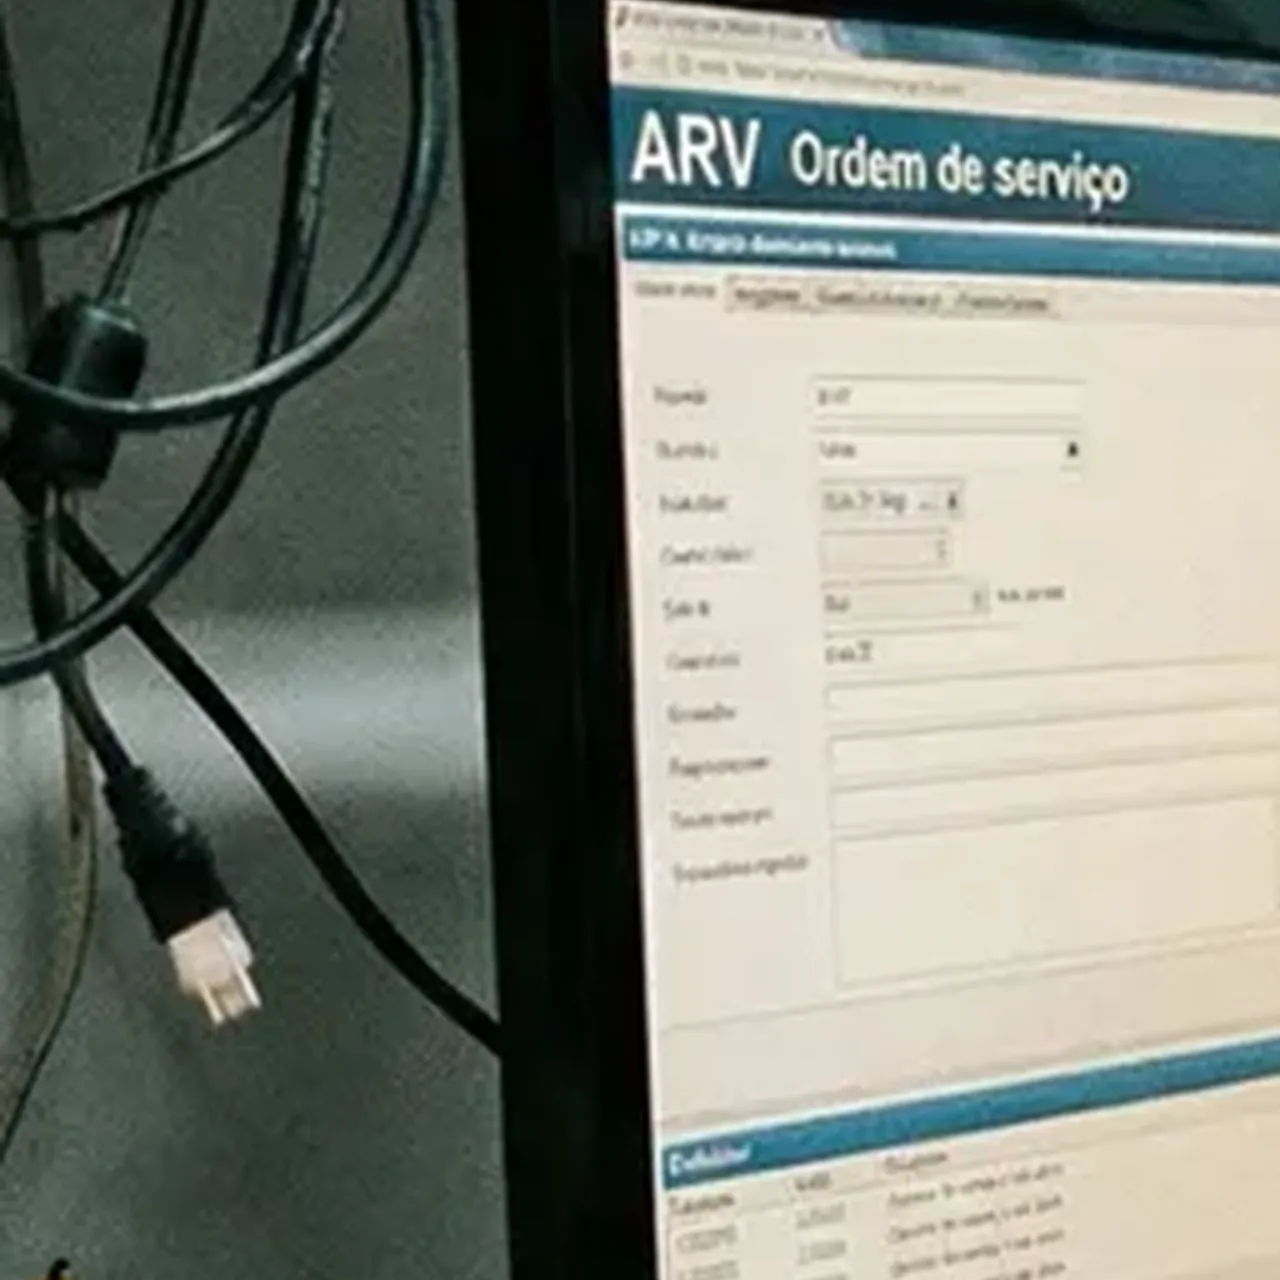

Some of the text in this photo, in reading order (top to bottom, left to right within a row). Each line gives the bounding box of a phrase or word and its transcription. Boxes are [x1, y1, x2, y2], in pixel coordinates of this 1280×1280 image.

[630, 109, 1129, 211] ARV Ordem de serviço
